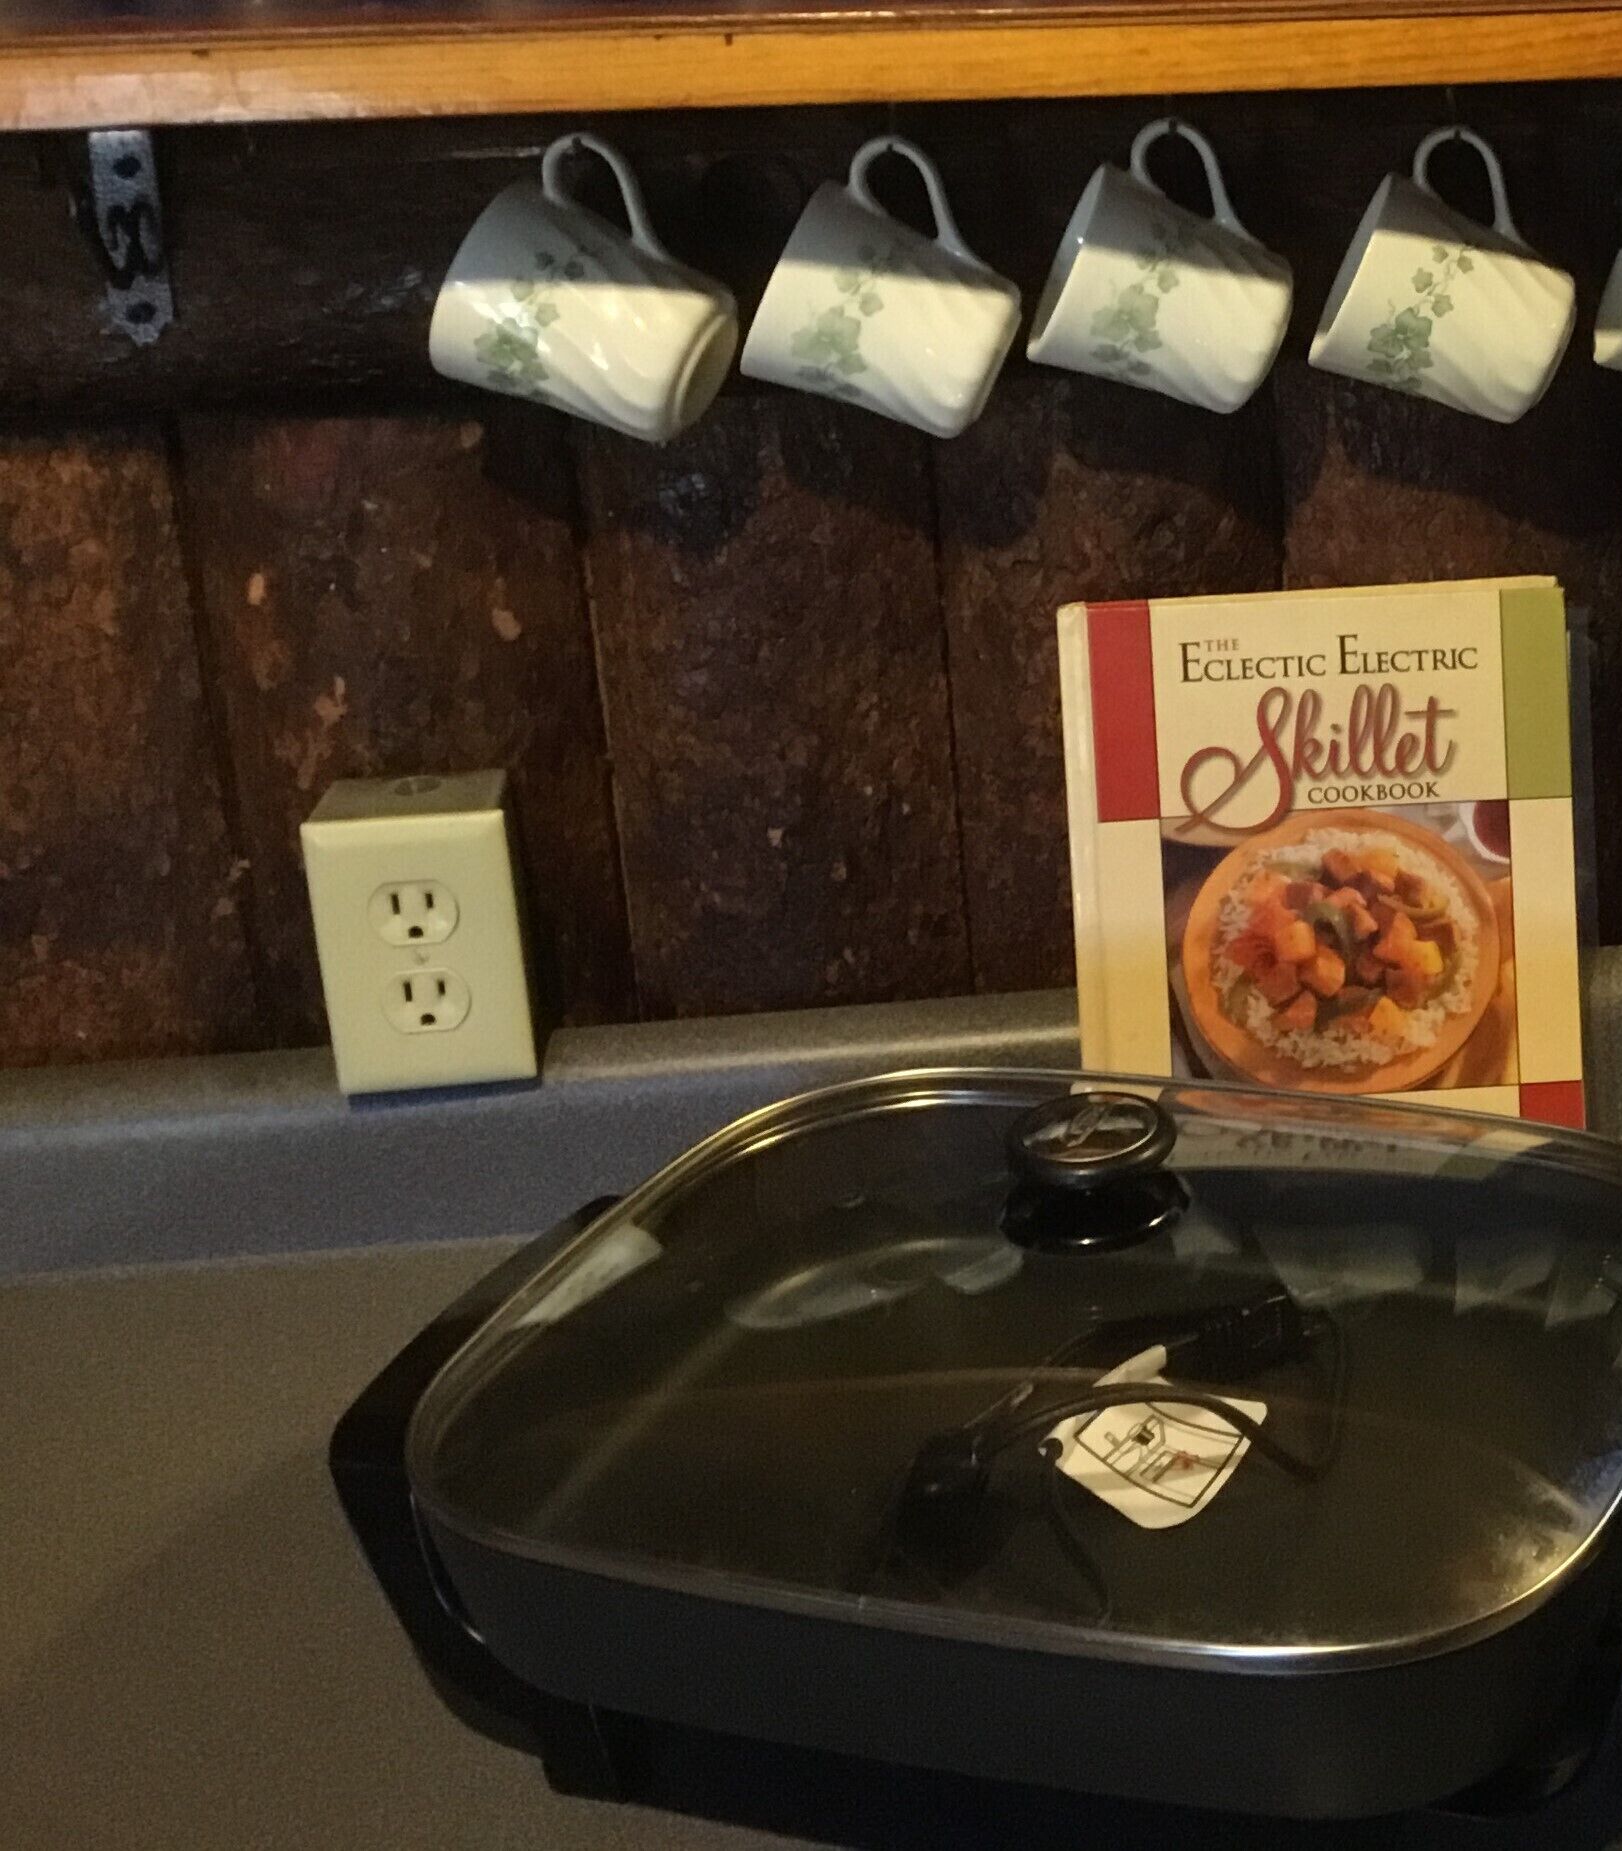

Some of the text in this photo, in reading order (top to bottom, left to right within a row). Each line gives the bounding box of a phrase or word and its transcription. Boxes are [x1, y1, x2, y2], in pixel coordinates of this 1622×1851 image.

[1179, 634, 1478, 683] ECLECTIC ELECTRIC
[1204, 639, 1240, 652] THE
[1174, 683, 1456, 836] Skillet
[1307, 781, 1440, 804] COOKBOOK
